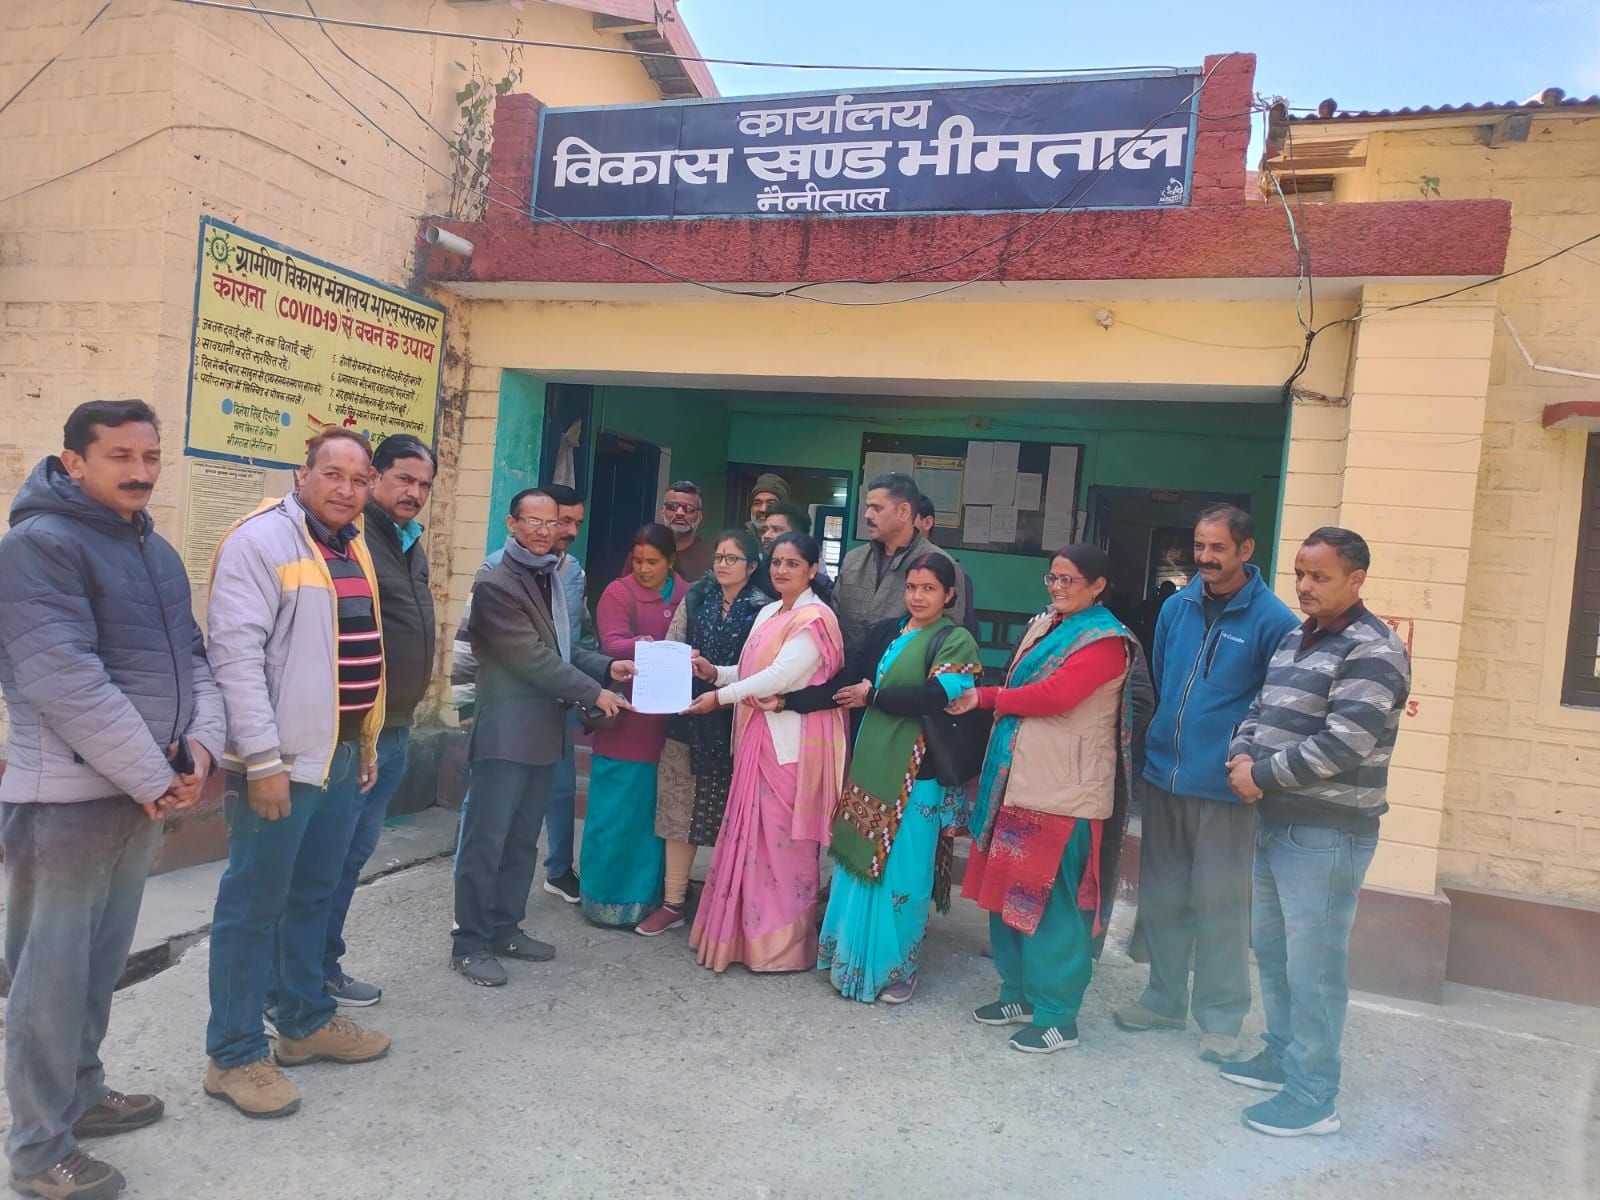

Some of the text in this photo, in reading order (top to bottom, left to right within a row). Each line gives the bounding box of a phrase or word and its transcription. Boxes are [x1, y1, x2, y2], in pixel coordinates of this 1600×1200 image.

[553, 114, 1188, 187] विकास खण्ड भीमताल
[737, 95, 932, 137] कार्यालय
[756, 183, 890, 213] नैनीताल
[212, 268, 267, 310] कोरोना
[400, 334, 436, 364] उपाय
[236, 246, 439, 338] ग्रामीण विकास मंत्रालय भारत सरकार
